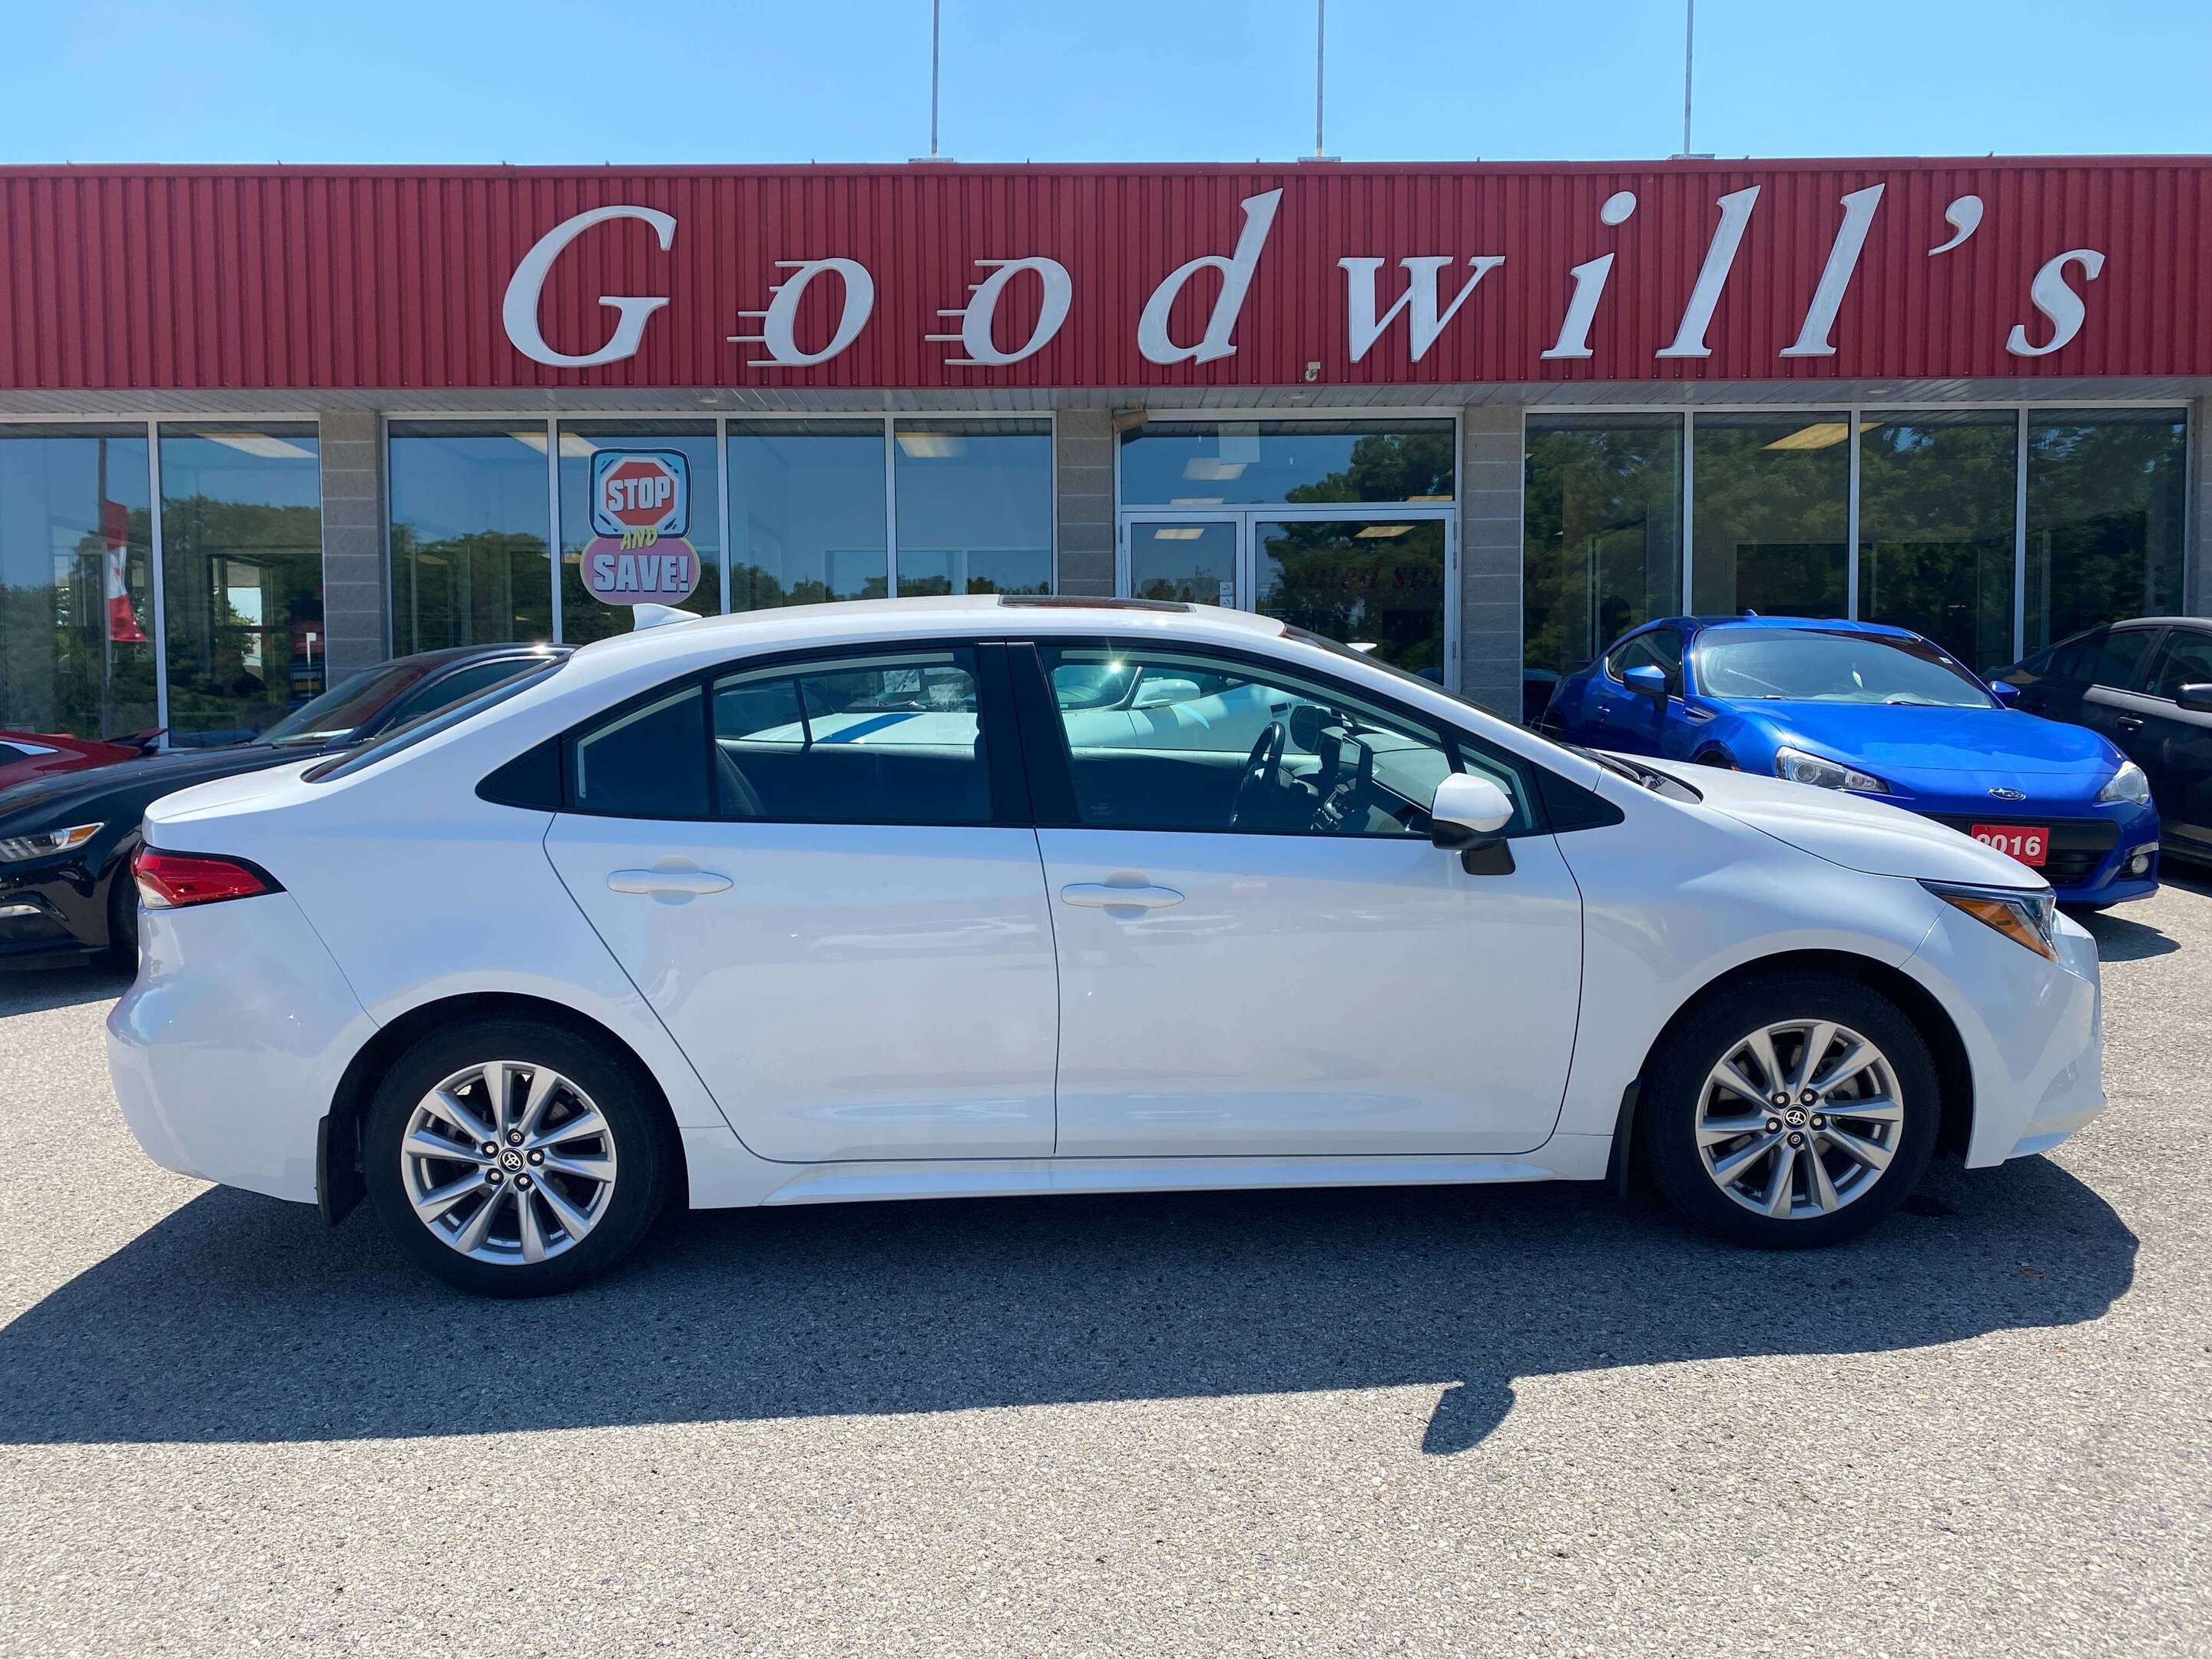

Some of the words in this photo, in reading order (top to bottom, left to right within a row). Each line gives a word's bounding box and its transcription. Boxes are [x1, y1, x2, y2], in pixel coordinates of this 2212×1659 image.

[502, 184, 2106, 368] Goodwill's
[607, 475, 671, 512] STOP
[620, 525, 659, 551] AND
[592, 553, 690, 593] SAVE!
